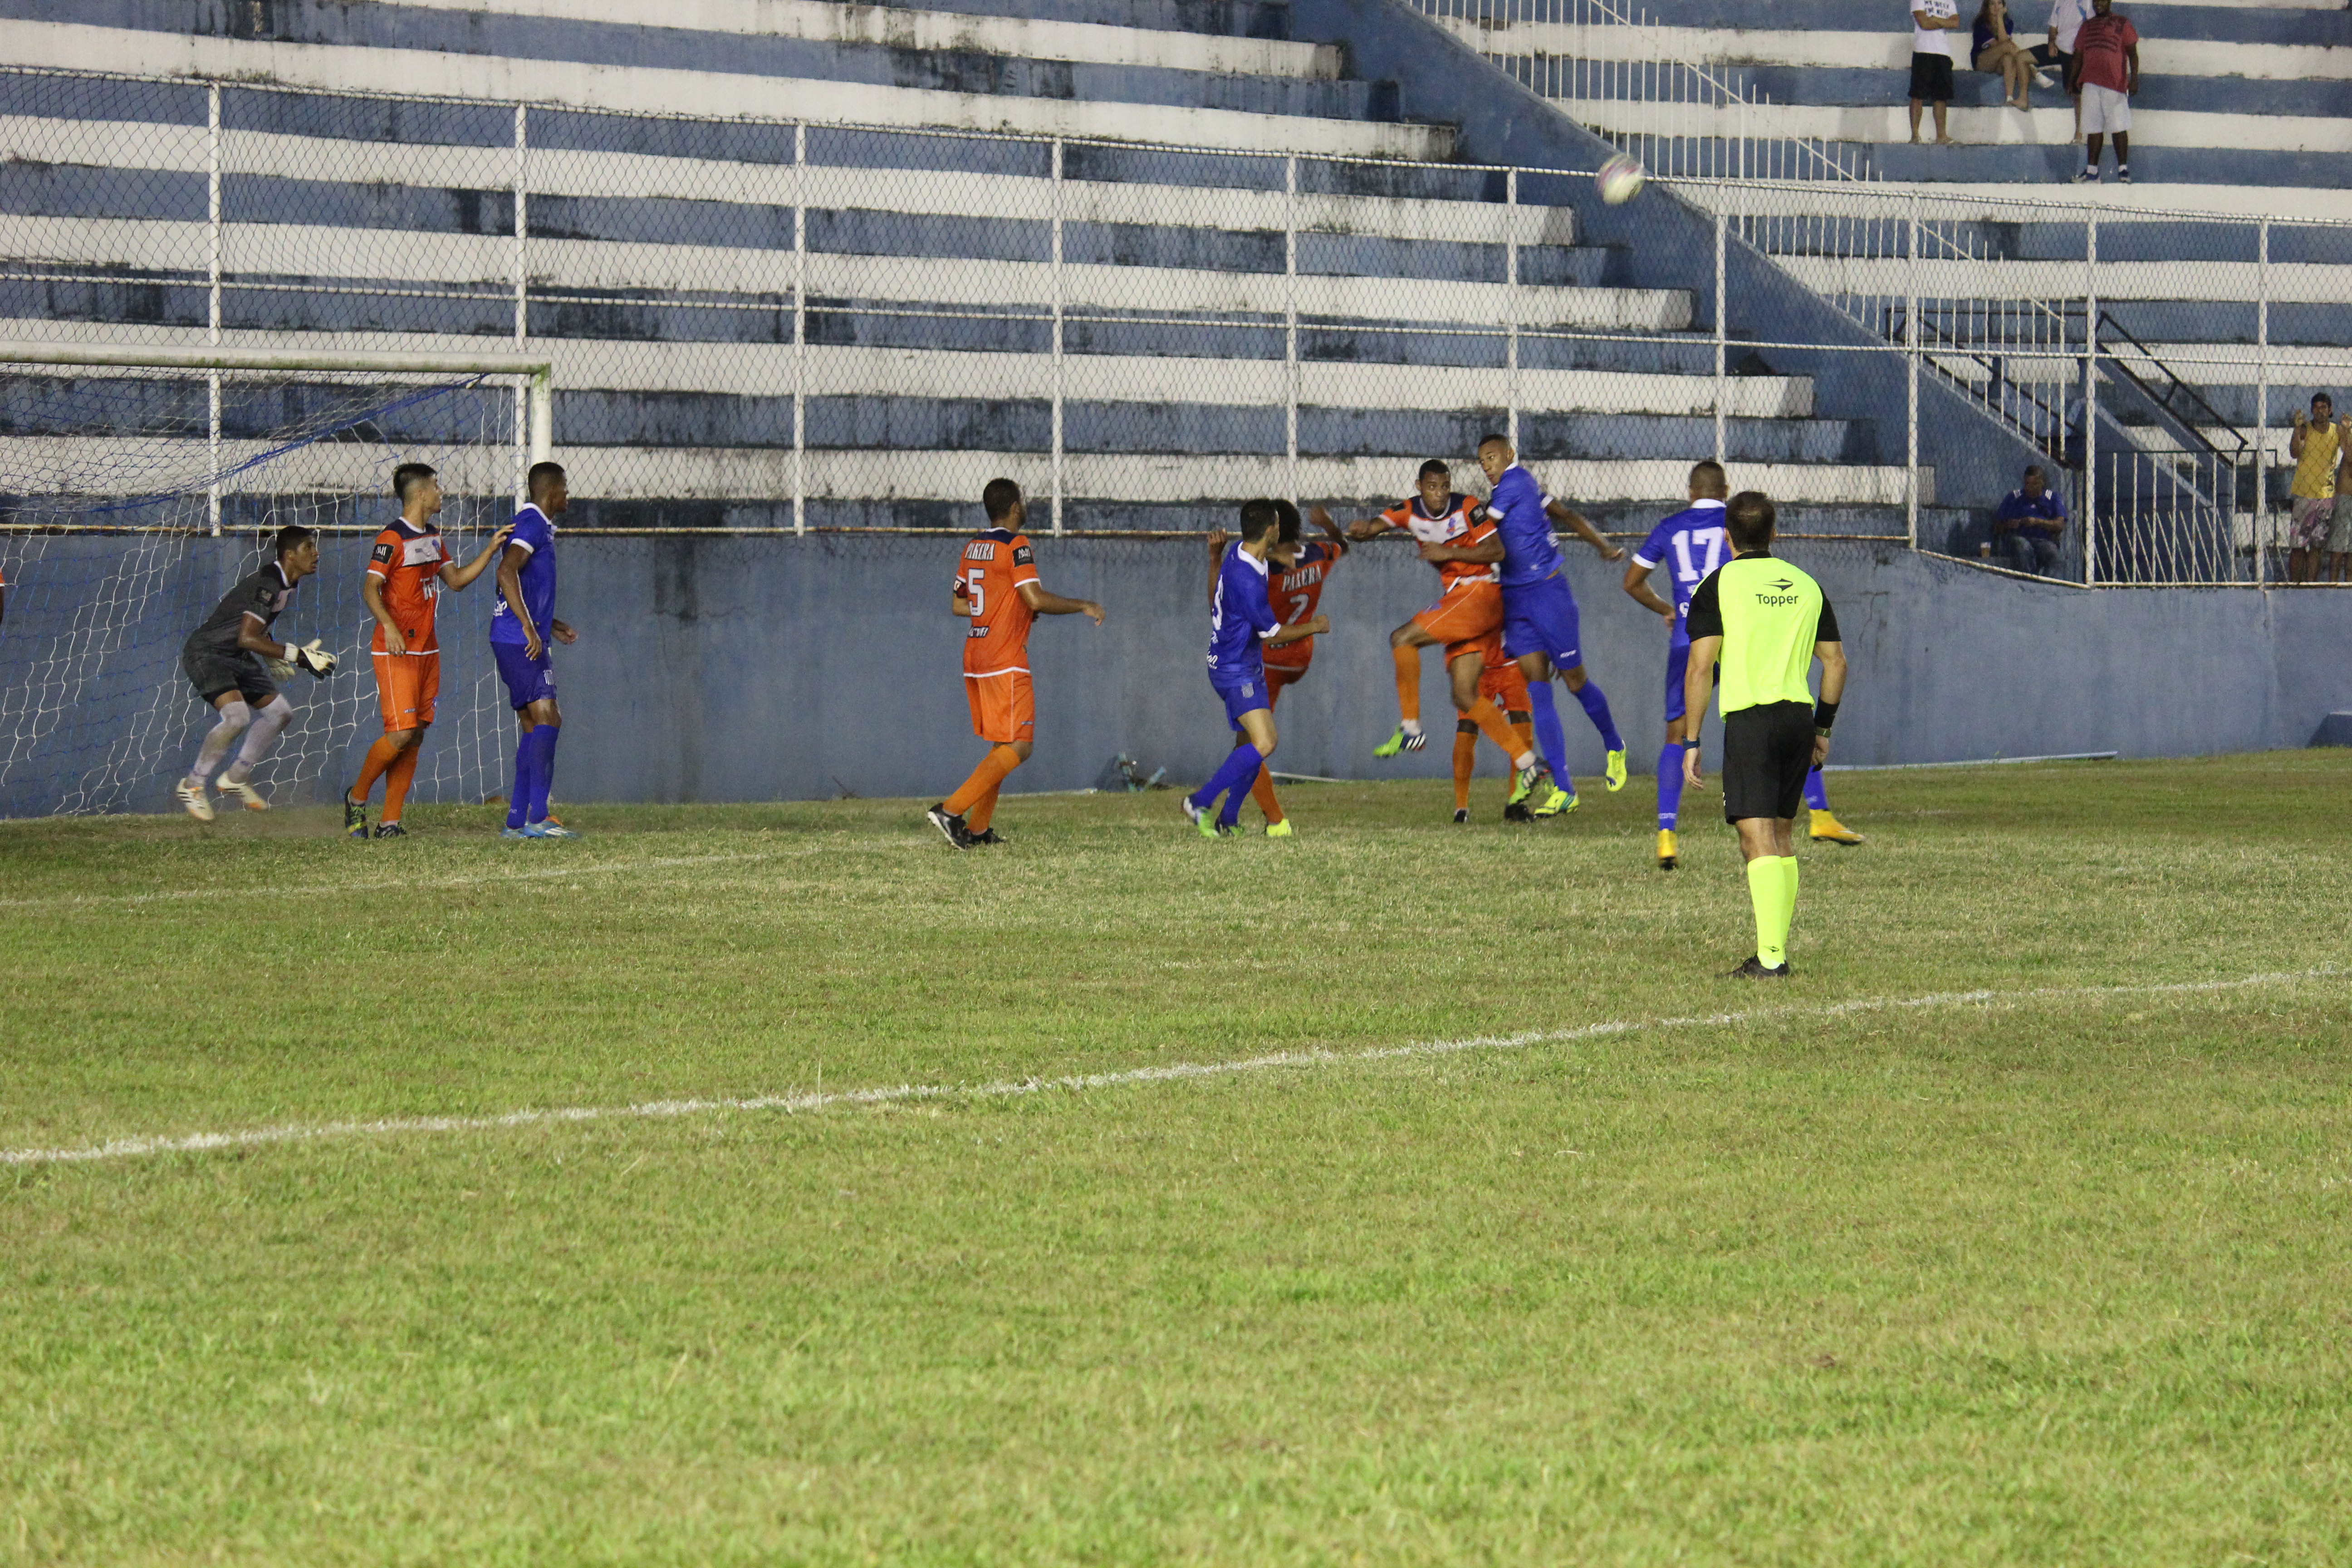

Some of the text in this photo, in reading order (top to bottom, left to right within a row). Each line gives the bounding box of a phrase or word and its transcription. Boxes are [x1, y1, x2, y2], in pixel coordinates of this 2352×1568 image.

[1671, 526, 1724, 582] 17
[968, 568, 984, 617] 5
[1755, 593, 1798, 607] Topper
